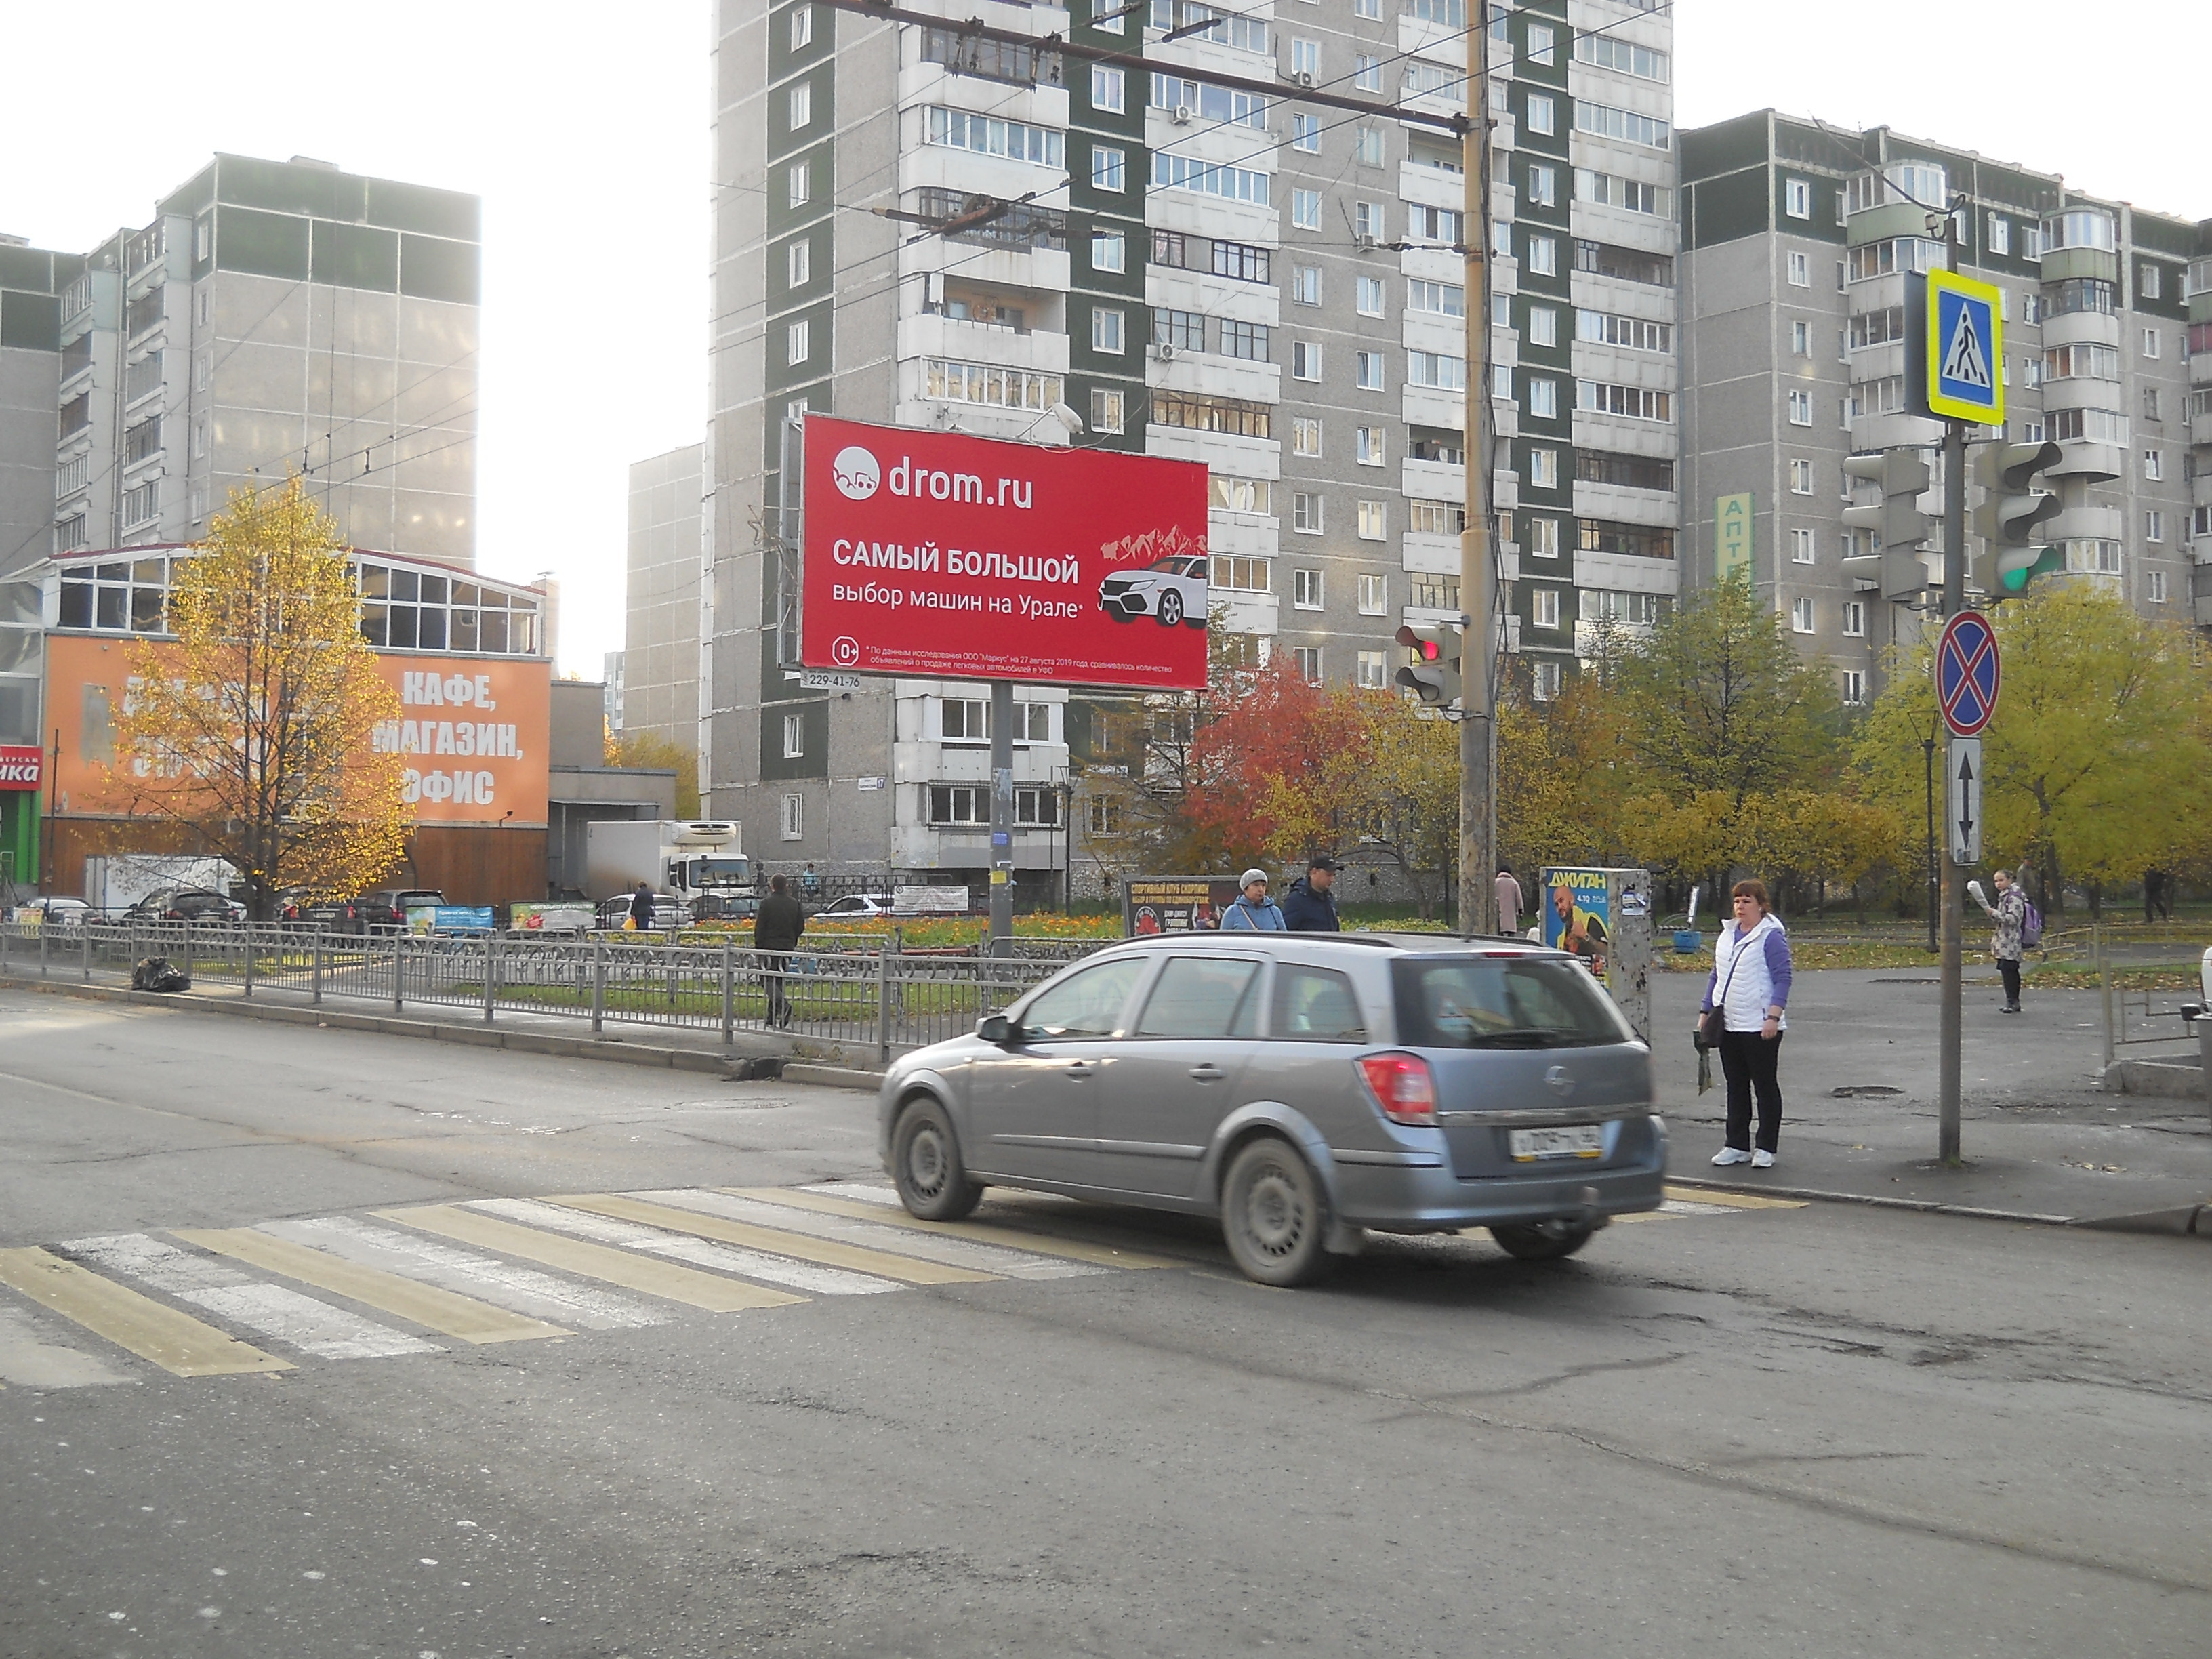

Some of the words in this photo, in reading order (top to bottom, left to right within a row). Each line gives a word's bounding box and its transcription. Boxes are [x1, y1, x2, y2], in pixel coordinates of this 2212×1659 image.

[889, 455, 1033, 509] drom.ru
[833, 539, 940, 573] САМЫЙ
[947, 550, 1079, 584] БОЛЬШОЙ
[833, 581, 903, 609] выбор
[910, 590, 983, 611] машин
[989, 596, 1012, 613] на
[840, 643, 857, 659] 0+
[870, 655, 914, 667] объявлений
[920, 660, 951, 670] продаже
[953, 662, 985, 670] легковых
[986, 663, 1031, 674] автомобилей
[1038, 666, 1054, 674] УФО
[882, 647, 912, 657] данным
[912, 650, 962, 660] исследования
[962, 653, 979, 661] ООО
[1029, 657, 1055, 667] августа
[1056, 658, 1072, 667] 2019
[1090, 661, 1135, 672] сравнивалось
[1136, 665, 1172, 674] количество
[403, 671, 496, 712] КАФЕ,
[809, 674, 860, 687] 229-41-76
[373, 720, 523, 760] МАГАЗИН,
[401, 769, 495, 805] ОФИС
[1548, 872, 1607, 890] ДЖИГАН
